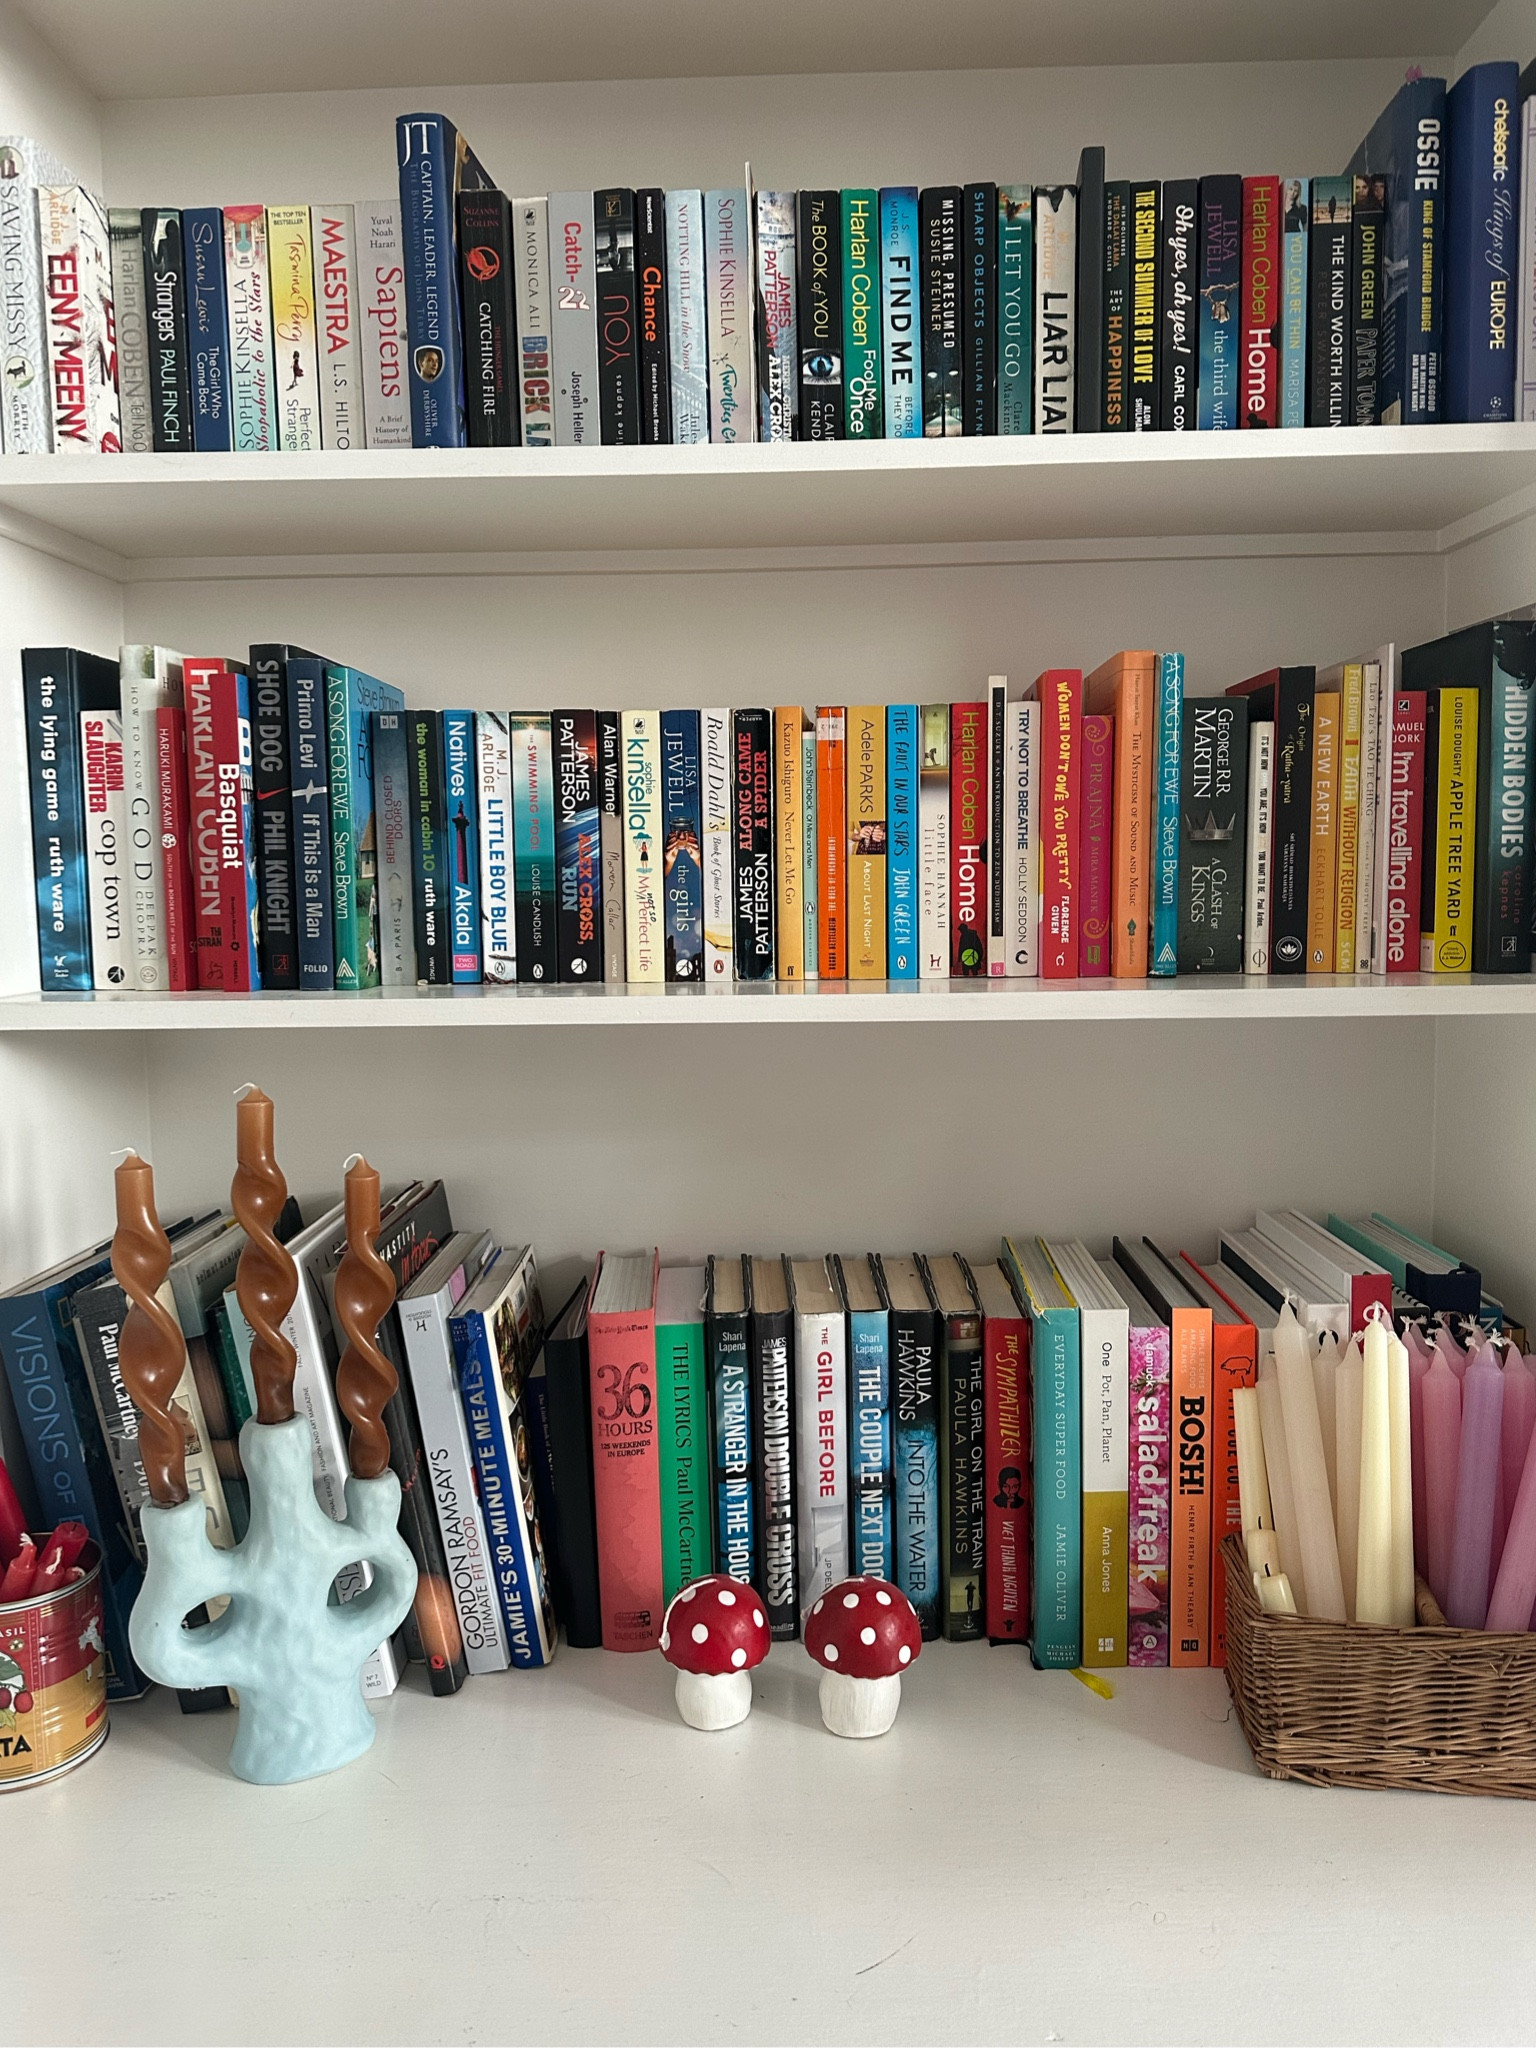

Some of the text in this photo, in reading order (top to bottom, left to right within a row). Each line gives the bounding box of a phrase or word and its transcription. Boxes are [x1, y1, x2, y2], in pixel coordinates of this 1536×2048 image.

[402, 122, 437, 166] JT
[1414, 118, 1440, 191] OSSIE
[370, 239, 395, 248] Harari
[371, 217, 392, 225] Yuval
[372, 228, 393, 237] Noah
[1005, 236, 1021, 280] LET
[1421, 200, 1433, 333] KING OF STAMFORD BRIDGE
[152, 271, 177, 341] Strangers
[321, 218, 349, 354] MAESTRA
[426, 286, 439, 340] LEGEND
[526, 232, 539, 328] MONICA ALI
[558, 287, 590, 310] 22
[811, 201, 828, 338] The BOOK of YOU
[850, 201, 870, 346] Harlan Coben
[1005, 287, 1021, 336] YOU
[1133, 190, 1155, 384] THE SECOND SUMMER OF LOVE
[1489, 280, 1505, 349] EUROPE
[48, 253, 89, 442] EENY MEENY
[368, 266, 404, 397] Sapiens
[480, 302, 496, 416] CATCHING FIRE
[890, 256, 912, 385] FIND ME
[1004, 342, 1020, 377] GO
[159, 349, 180, 443] PAUL FINCH
[571, 371, 584, 444] Joseph Heller
[1107, 315, 1123, 425] HAPPINESS
[39, 676, 58, 821] the lying game
[256, 660, 282, 772] SHOE DOG
[297, 679, 317, 769] Primo Levi
[448, 721, 465, 797] Natives
[85, 721, 106, 813] SLAUGHTER
[105, 742, 124, 791] KARIN
[416, 722, 435, 871] the woman in cabin 10
[603, 725, 618, 818] Alan Warner
[894, 710, 909, 857] THE FAULT IN OUR STARS
[1017, 709, 1029, 850] TRY NOT TO BREATHE
[1501, 686, 1528, 858] HIDDEN BODIES
[218, 764, 242, 869] Basquiat
[1447, 780, 1463, 919] APPLE TREE YARD
[48, 837, 64, 932] ruth ware
[95, 819, 120, 940] cop town
[263, 811, 290, 935] PHIL KNIGHT
[424, 879, 436, 945] ruth ware
[454, 887, 470, 945] Akala
[488, 799, 507, 952] LITTLE BOY BLUE
[892, 868, 910, 945] JOHN GREEN
[304, 965, 327, 973] FOLIO
[719, 1342, 746, 1352] Lapena
[722, 1332, 742, 1342] Shari
[762, 1337, 786, 1348] JAMES
[817, 1351, 833, 1402] GIRL
[898, 1330, 916, 1421] HAWKINS
[916, 1346, 932, 1406] PAULA
[597, 1361, 652, 1420] 36
[598, 1420, 653, 1437] HOURS
[672, 1343, 691, 1449] THE LYRICS
[761, 1348, 788, 1437] PATTERSON
[1053, 1334, 1066, 1499] EVERYDAY SUPER FOOD
[1101, 1342, 1112, 1463] One Pot, Pan, Planet
[612, 1439, 651, 1449] WEEKENDS
[617, 1448, 645, 1457] EUROPE
[677, 1457, 693, 1494] Paul
[818, 1411, 835, 1498] BEFORE
[858, 1366, 882, 1538] THE COUPLE NEXT
[1137, 1396, 1168, 1583] salad freak
[1180, 1396, 1205, 1496] BOSH!
[430, 1448, 485, 1650] GORDON RAMSAY'S
[467, 1359, 531, 1660] JAMIE'S 30-MINUTE MEALS
[763, 1438, 794, 1606] DOUBLE CROSS
[907, 1440, 925, 1592] INTO THE WATER
[1187, 1504, 1195, 1533] HENRY
[1187, 1536, 1195, 1561] FIRTH
[464, 1516, 498, 1647] ULTIMATE FIT FOOD
[1056, 1523, 1066, 1622] JAMIE OLIVER
[1102, 1526, 1112, 1593] Anna Jones
[1187, 1573, 1195, 1587] IAN
[1186, 1591, 1195, 1629] THEASBY
